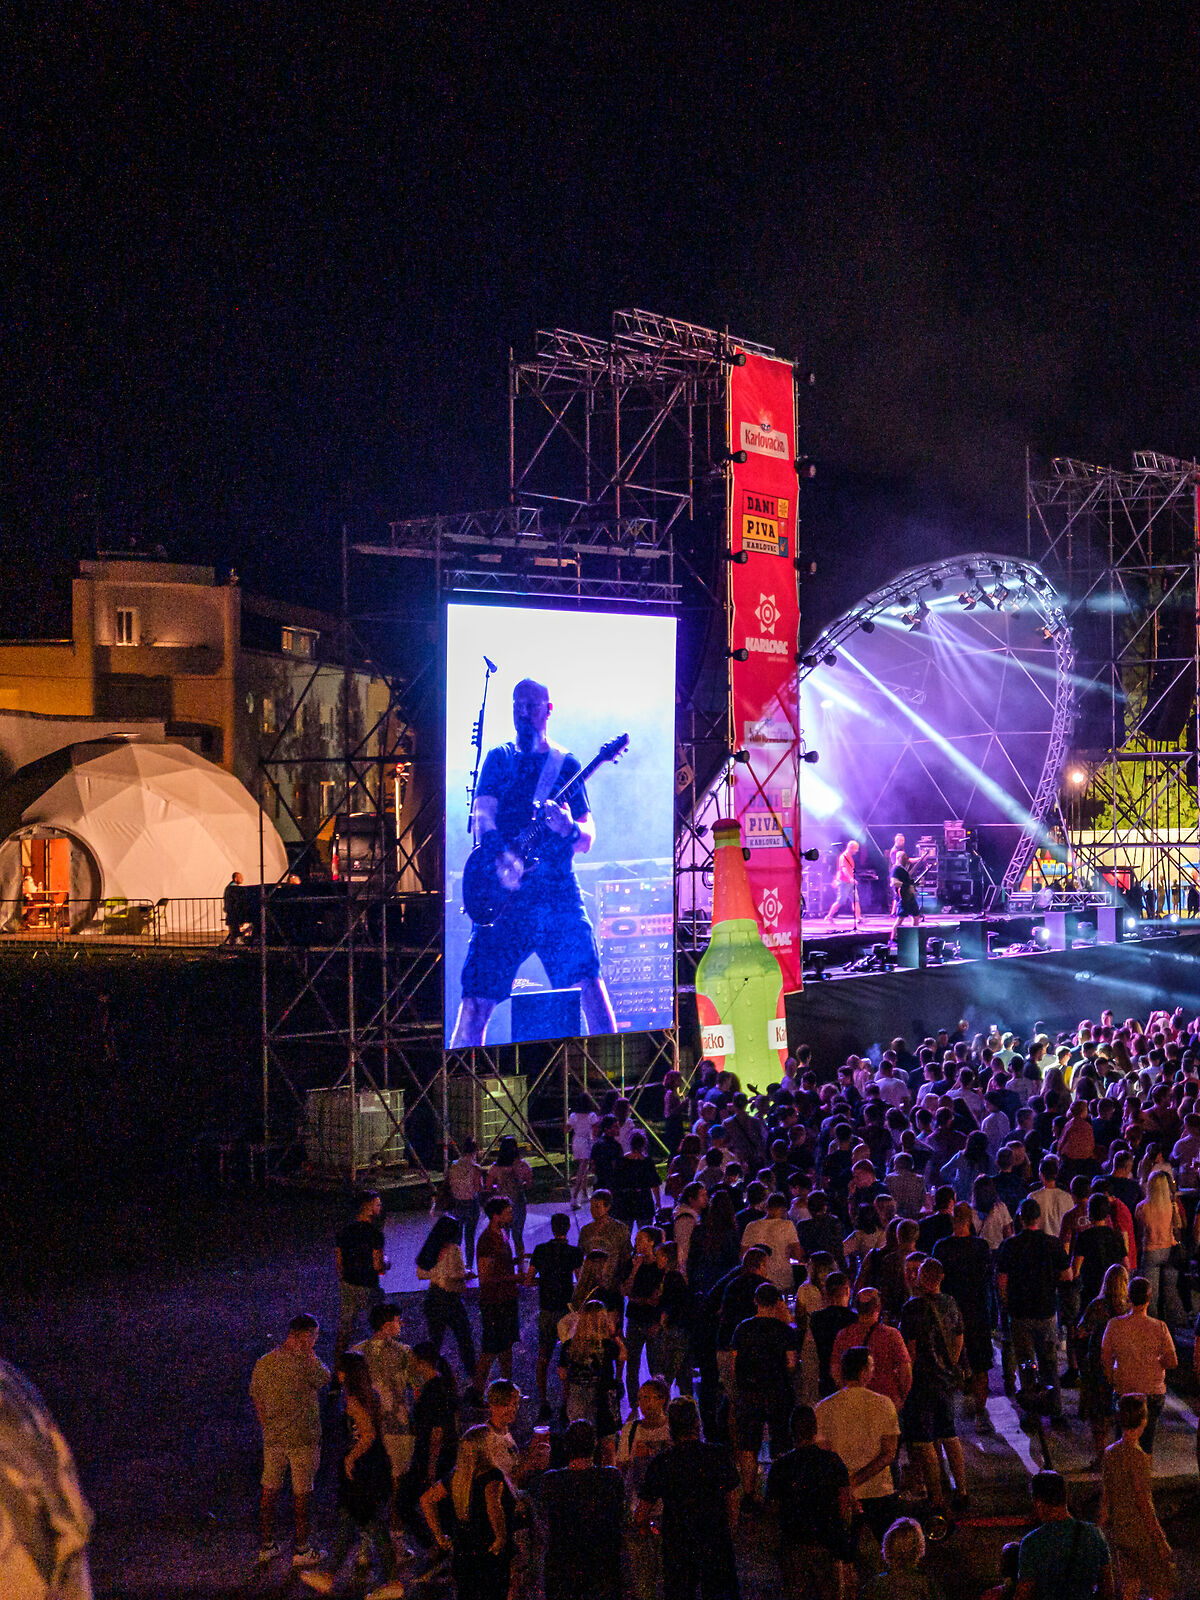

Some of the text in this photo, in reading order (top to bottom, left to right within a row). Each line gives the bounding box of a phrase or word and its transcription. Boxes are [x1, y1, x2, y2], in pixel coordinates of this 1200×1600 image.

[747, 496, 774, 515] DANI
[747, 520, 775, 538] PIVA
[749, 817, 780, 831] PIVA
